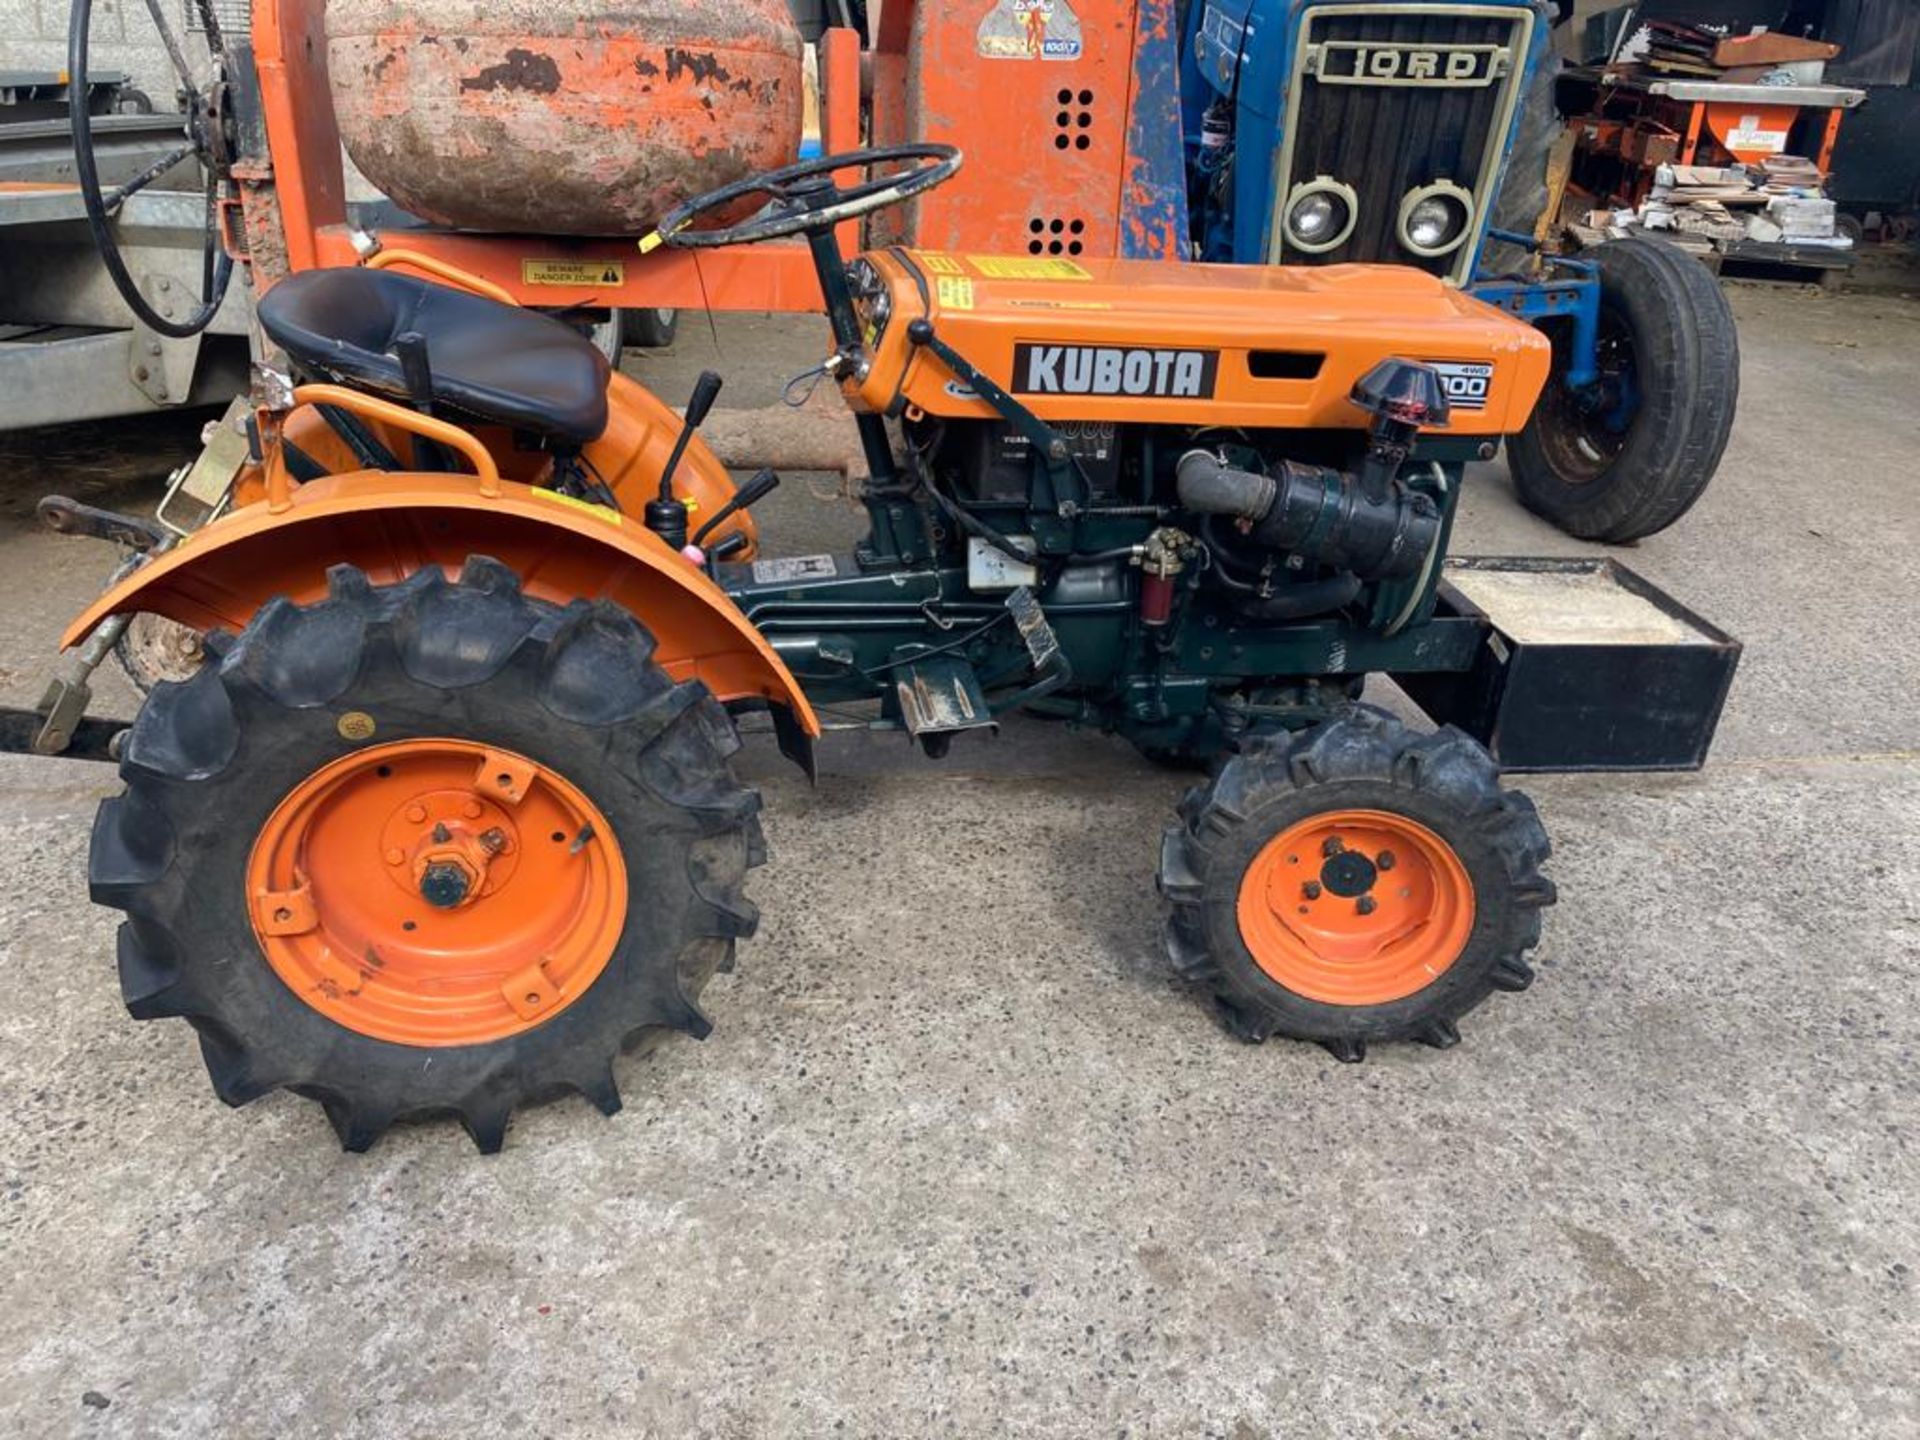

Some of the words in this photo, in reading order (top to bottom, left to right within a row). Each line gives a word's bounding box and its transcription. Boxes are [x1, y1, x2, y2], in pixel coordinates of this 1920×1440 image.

[534, 273, 572, 281] DANGER
[1028, 346, 1204, 396] KUBOTA
[1461, 368, 1489, 376] 4WD
